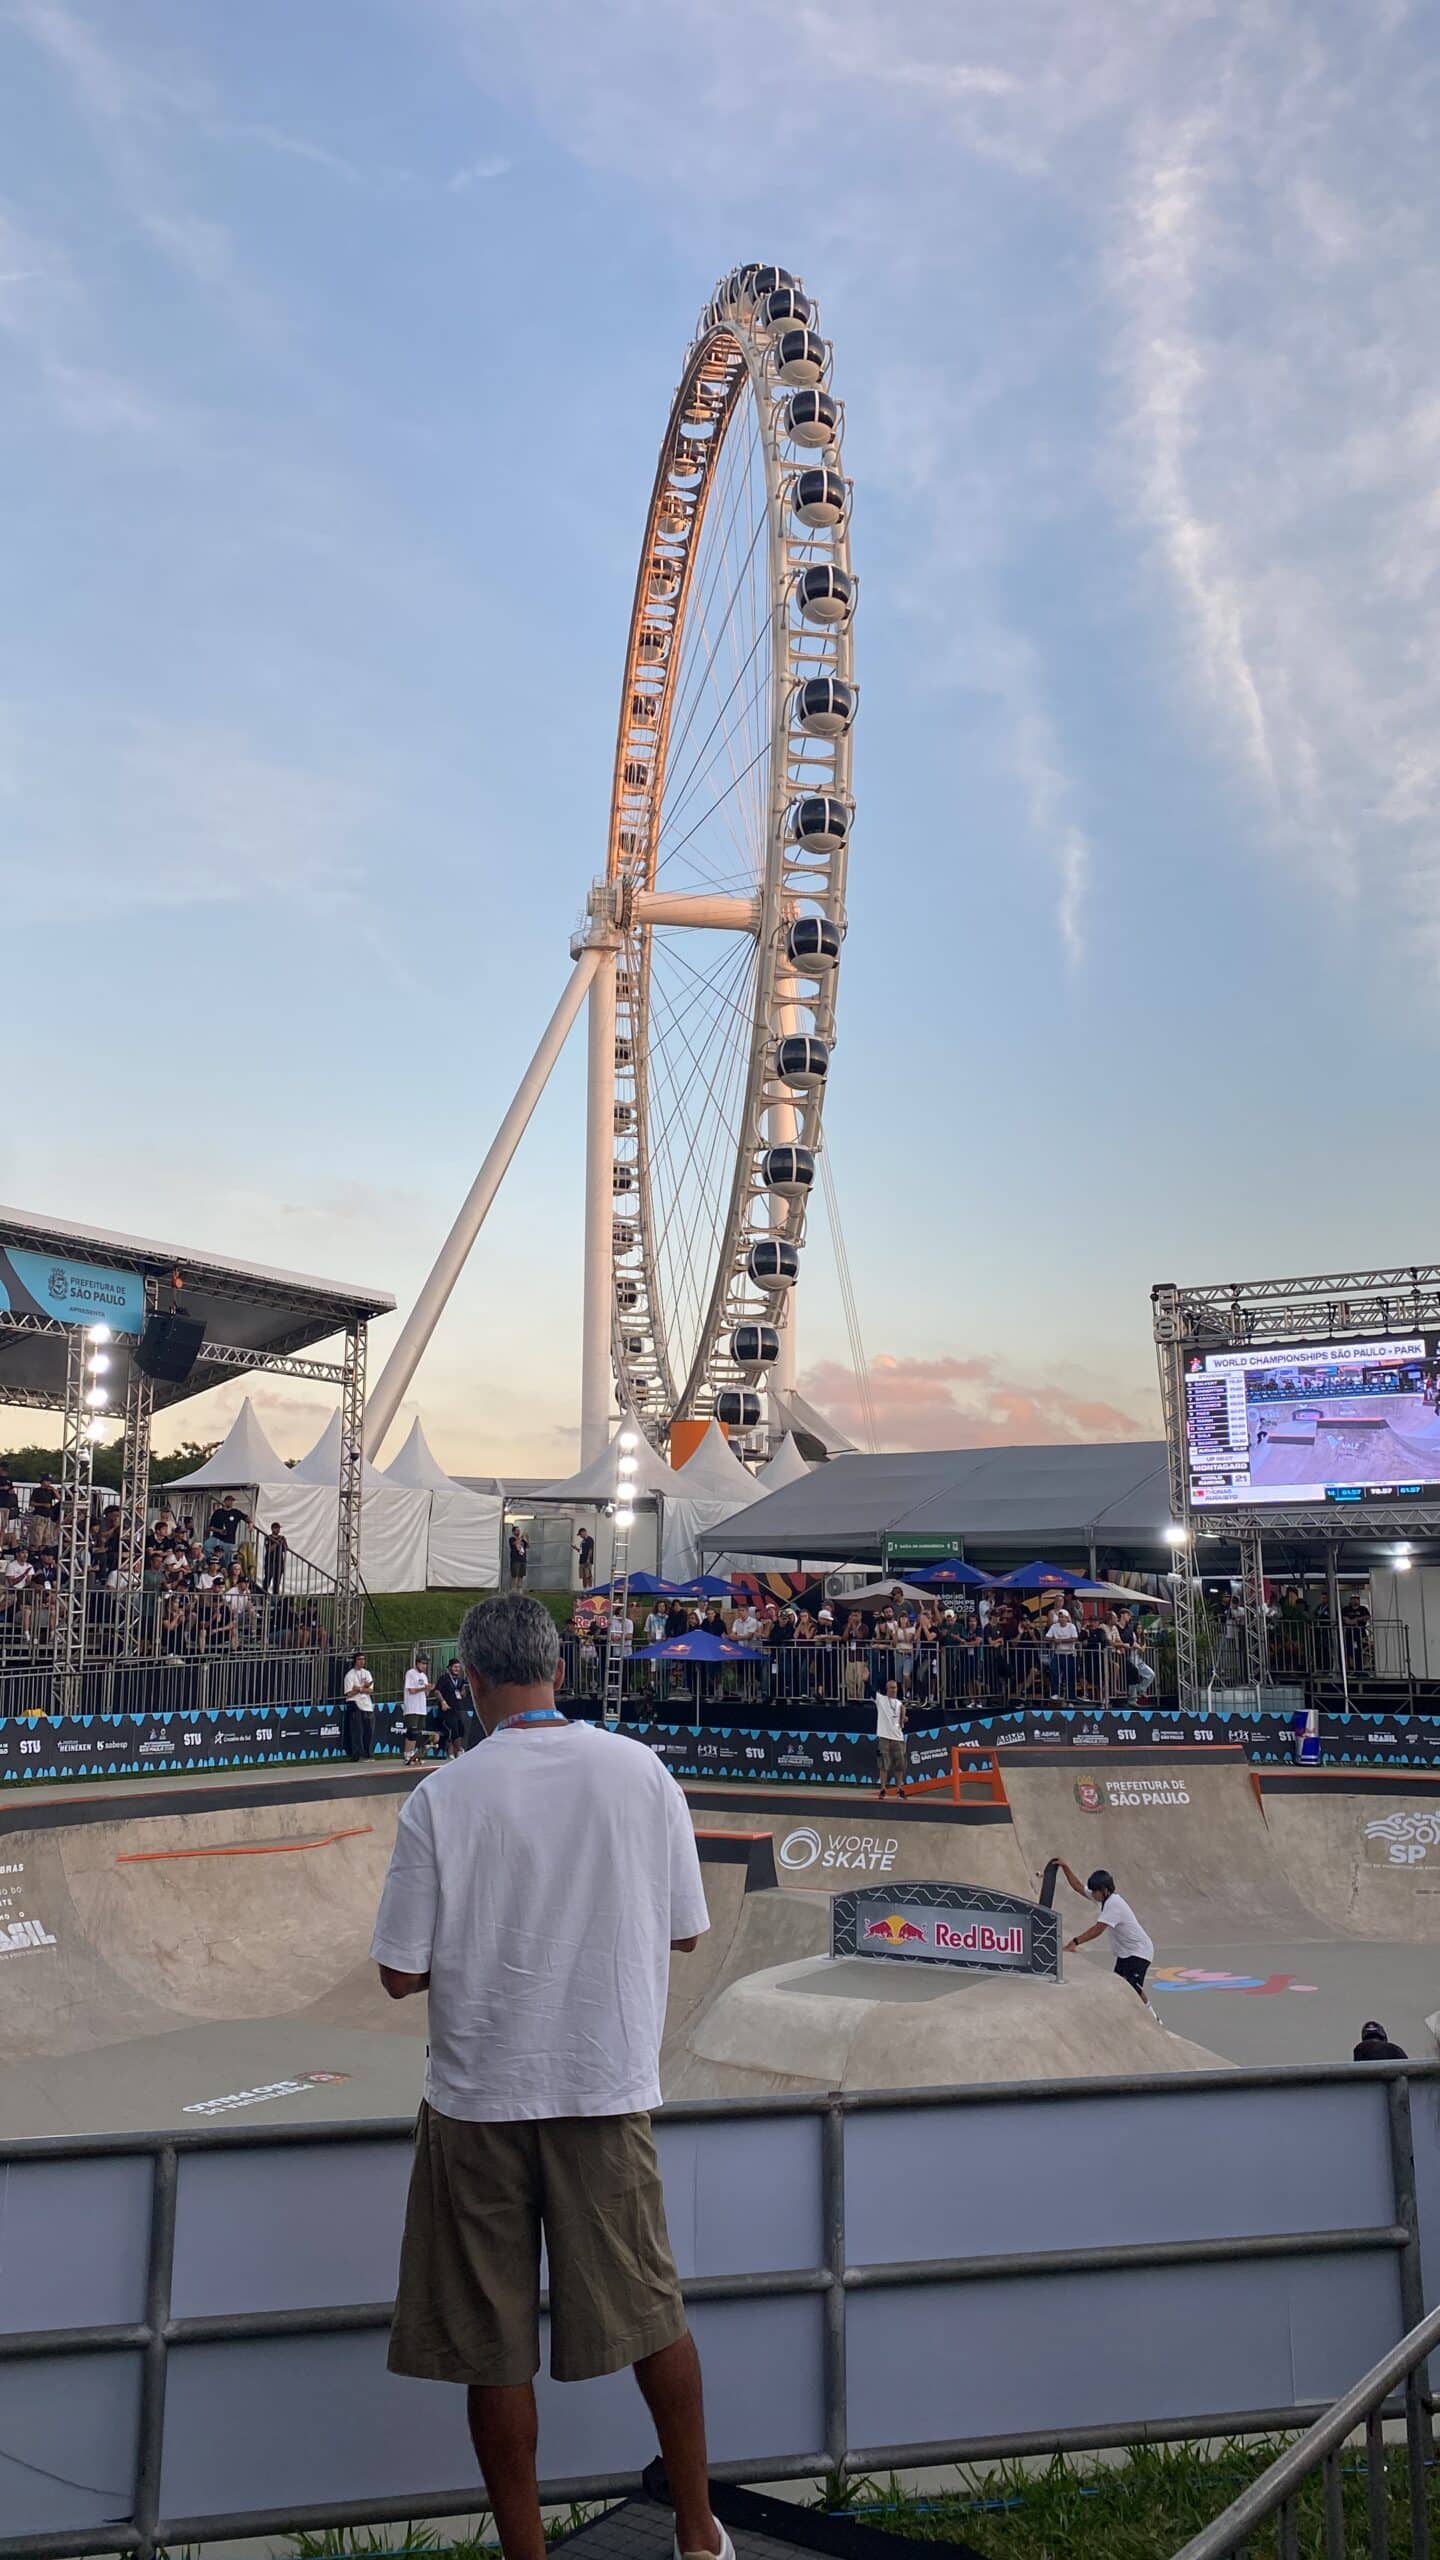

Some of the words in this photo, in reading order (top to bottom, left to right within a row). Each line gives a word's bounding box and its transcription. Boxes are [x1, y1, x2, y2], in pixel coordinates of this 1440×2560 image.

[69, 1277, 114, 1293] PREFEITURA
[116, 1285, 126, 1294] DE
[69, 1286, 92, 1300] SÃO
[93, 1292, 126, 1306] PAULO
[1213, 1357, 1247, 1368] WORLD
[1249, 1351, 1329, 1365] CHAMPIONSHIPS
[1330, 1348, 1351, 1360] SÃO
[1353, 1346, 1386, 1357] PAULO
[1394, 1345, 1422, 1355] PARK
[184, 1733, 202, 1746] STU
[256, 1728, 273, 1741] STU
[1117, 1729, 1137, 1741] STU
[1193, 1729, 1214, 1741] STU
[20, 1740, 41, 1754] STU
[60, 1743, 92, 1753] HEINEKEN
[745, 1747, 765, 1759] STU
[822, 1750, 842, 1762] STU
[1105, 1780, 1170, 1792] PREFEITURA
[1172, 1780, 1186, 1790] DE
[1110, 1791, 1140, 1806] SÃO
[1144, 1792, 1190, 1806] PAULO
[828, 1834, 899, 1854] WORLD
[821, 1850, 896, 1872] SKATE
[1388, 1844, 1426, 1864] SP
[935, 1921, 977, 1951] Red
[980, 1926, 1024, 1954] Bull
[182, 2092, 256, 2113] PAULO
